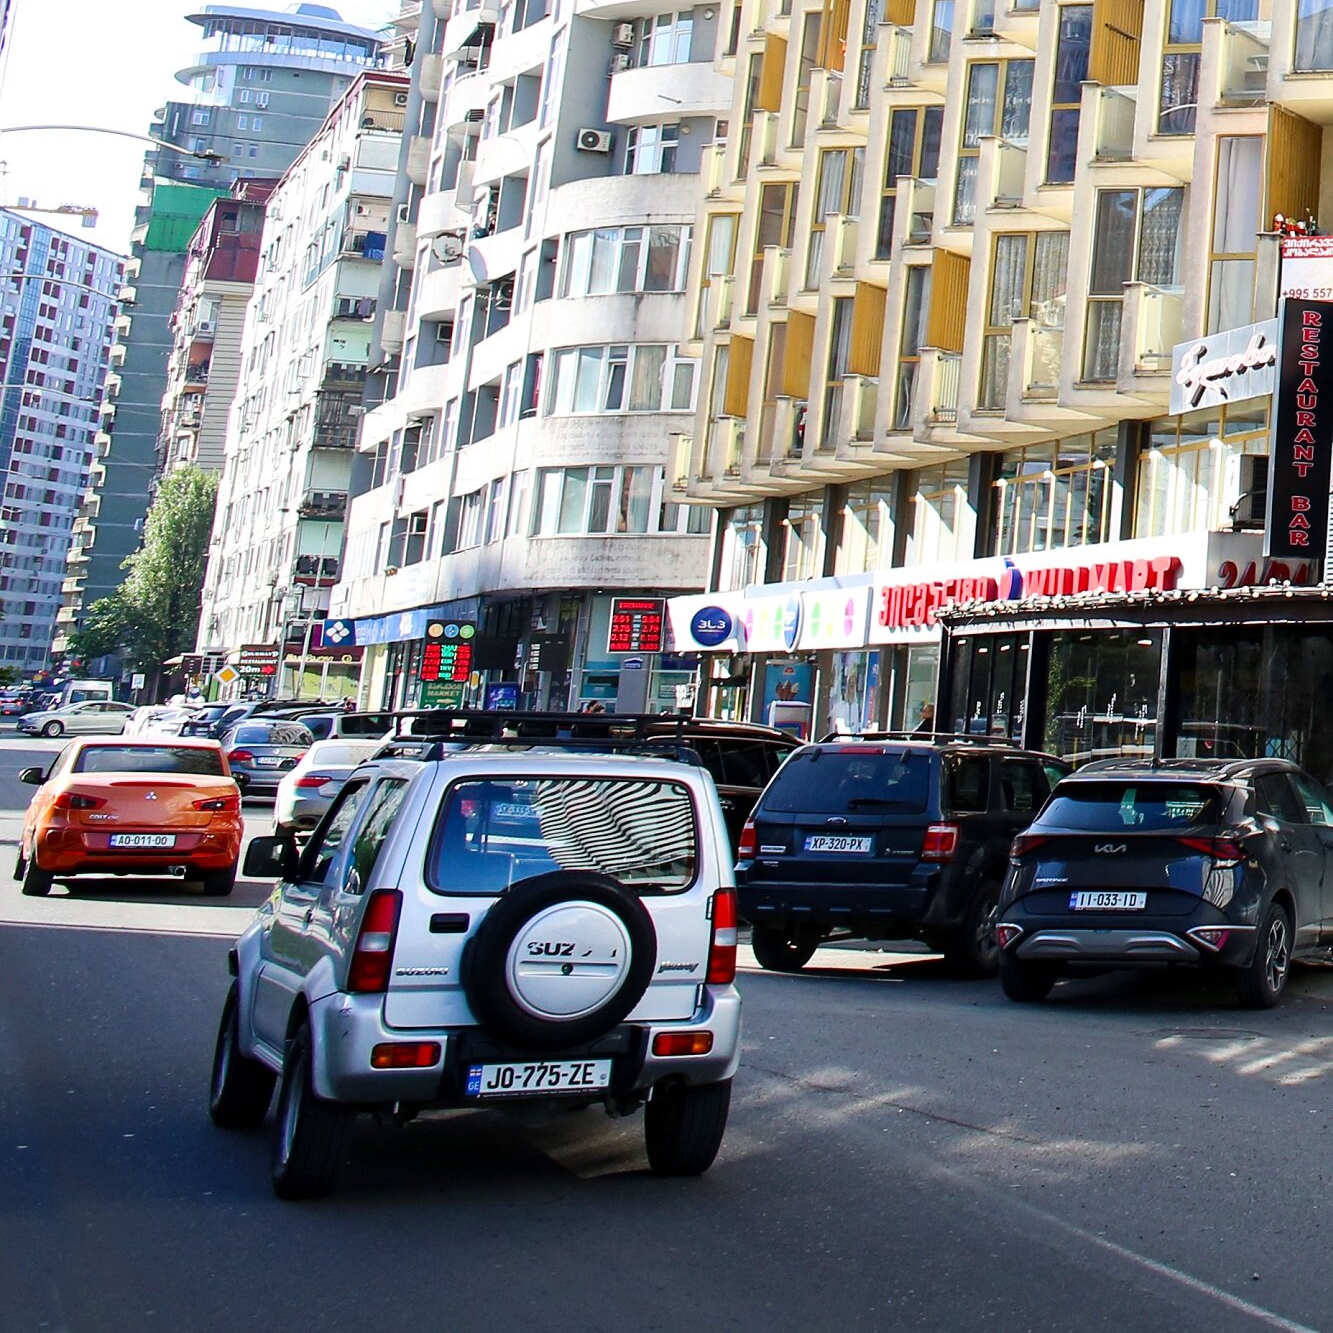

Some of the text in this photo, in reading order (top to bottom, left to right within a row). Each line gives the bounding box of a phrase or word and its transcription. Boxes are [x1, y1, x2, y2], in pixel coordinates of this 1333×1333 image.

[1282, 288, 1332, 299] +995 557
[1294, 310, 1322, 478] RESTAURANT
[1287, 495, 1311, 547] BAR
[239, 665, 260, 673] 20m
[811, 837, 863, 851] XP-320-PX
[396, 967, 449, 976] SUZUKI
